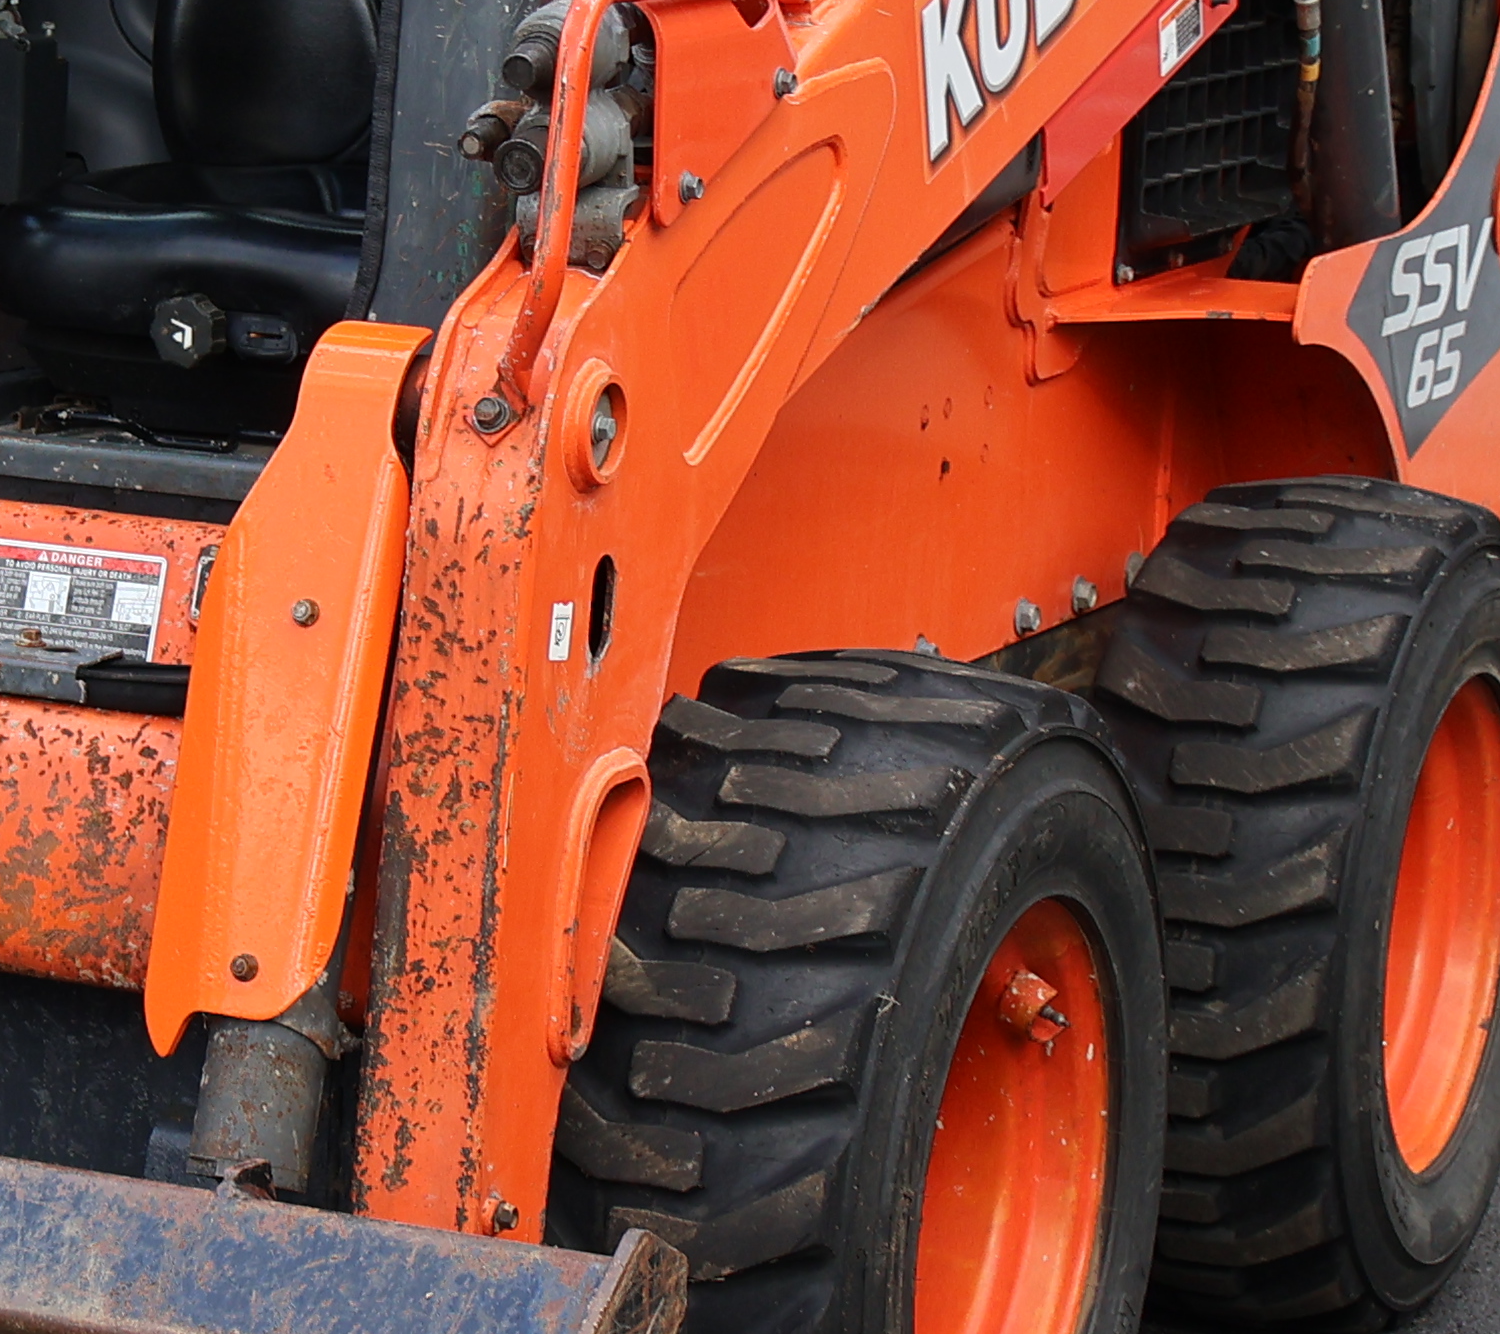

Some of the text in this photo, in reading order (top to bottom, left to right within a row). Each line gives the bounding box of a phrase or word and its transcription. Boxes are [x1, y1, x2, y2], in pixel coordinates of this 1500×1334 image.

[1381, 217, 1493, 337] SSV
[1407, 320, 1467, 408] 65
[5, 559, 131, 579] TO AVOID PERSONAL INJURY OR DEATH
[50, 552, 103, 566] DANGER
